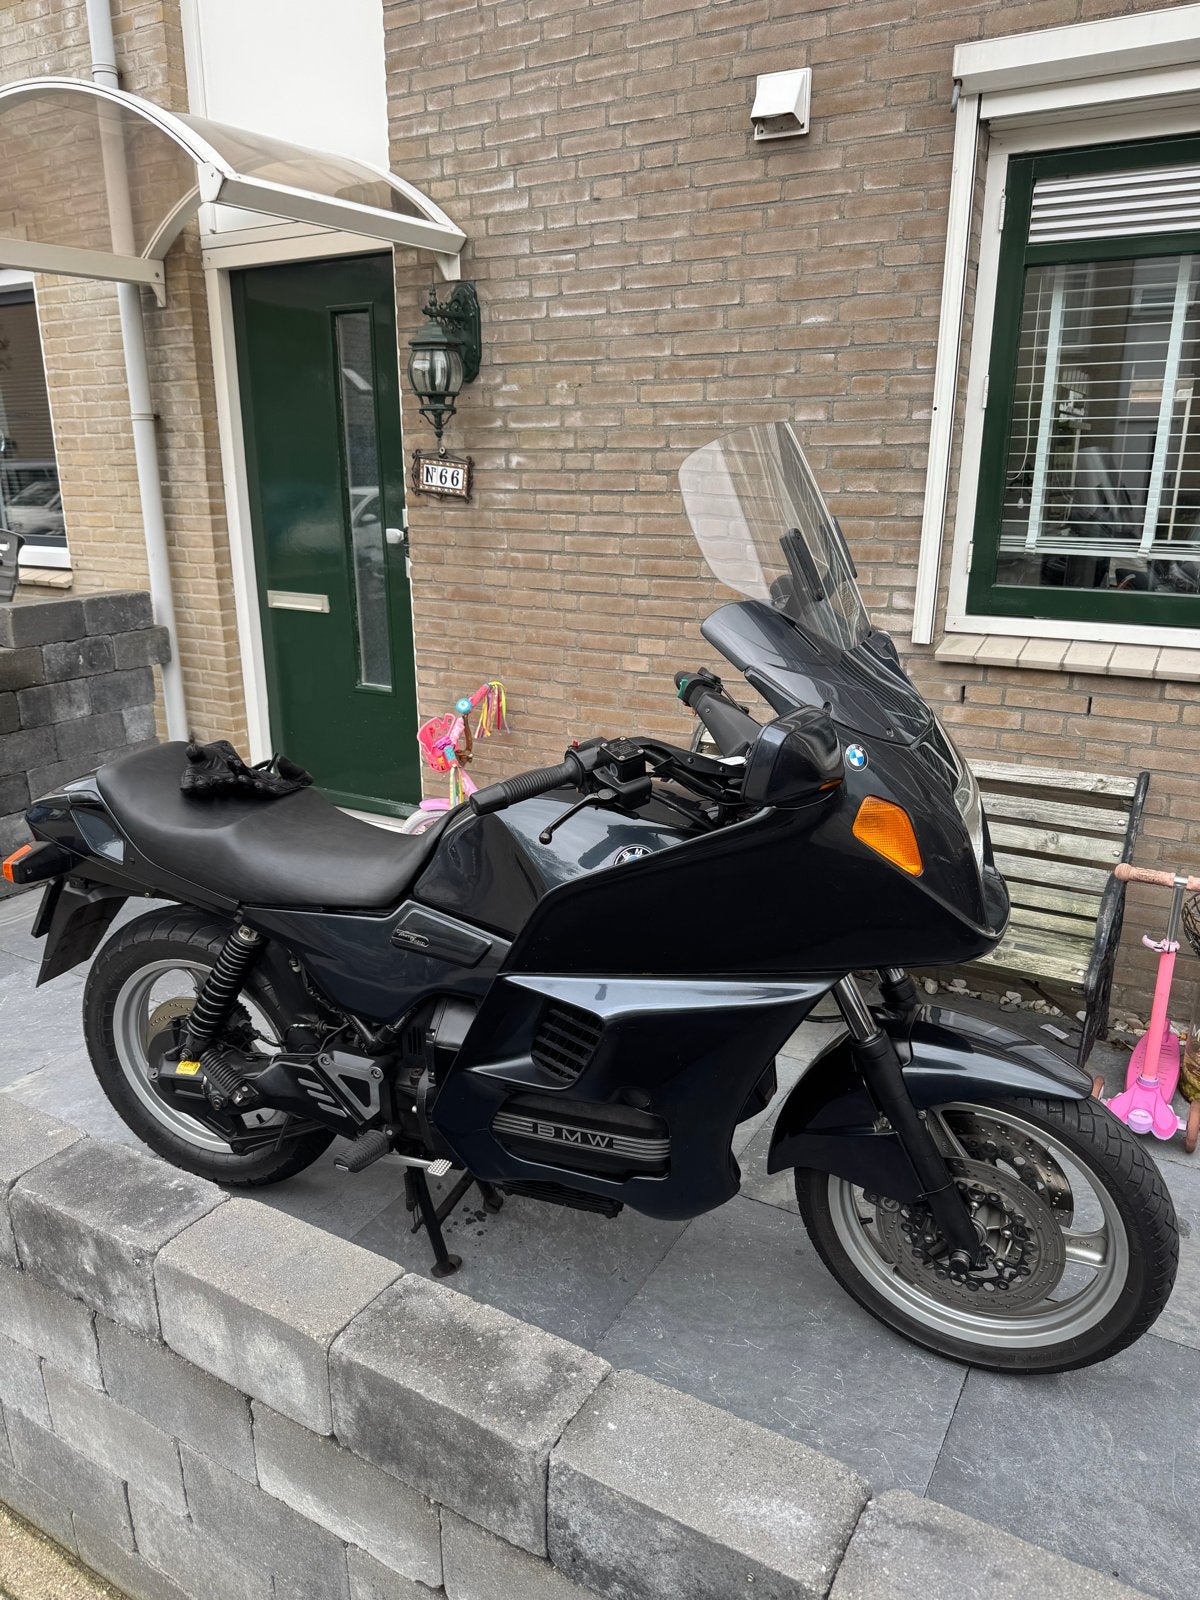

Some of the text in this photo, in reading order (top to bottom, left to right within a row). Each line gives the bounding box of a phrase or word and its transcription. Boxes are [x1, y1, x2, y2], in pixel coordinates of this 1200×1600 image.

[439, 468, 460, 487] 66
[622, 848, 643, 859] BM
[537, 1123, 610, 1148] BMW
